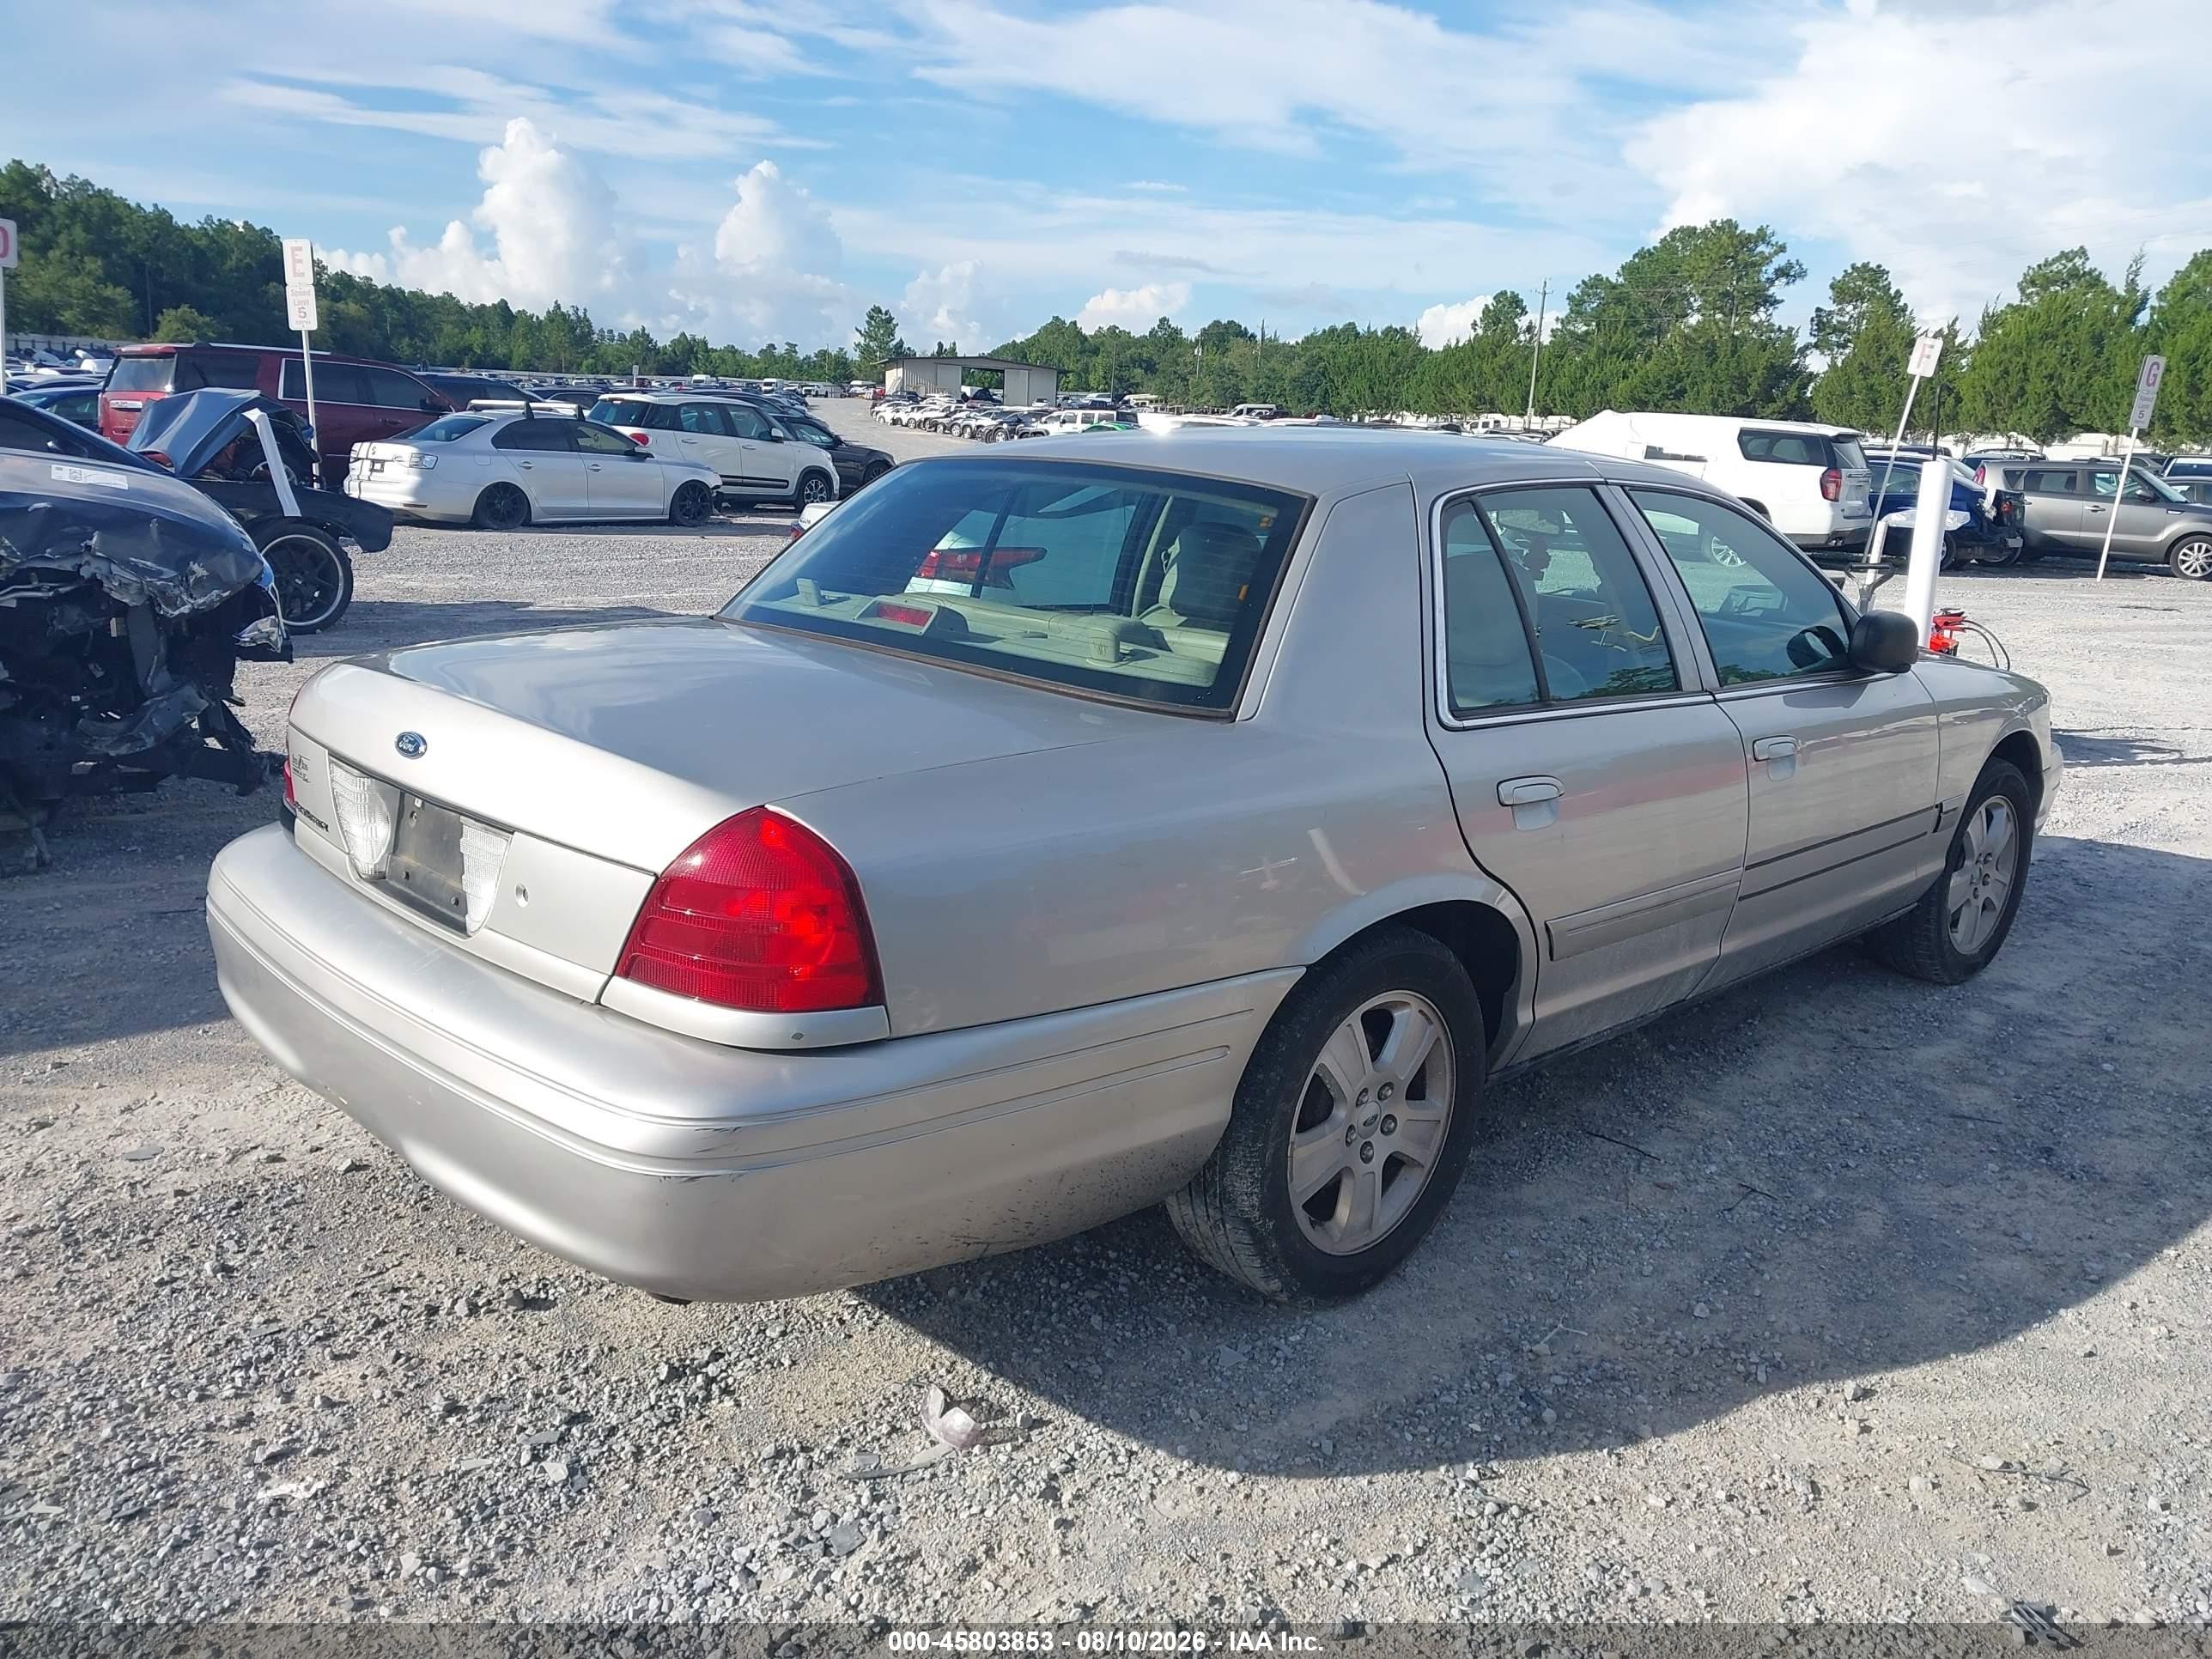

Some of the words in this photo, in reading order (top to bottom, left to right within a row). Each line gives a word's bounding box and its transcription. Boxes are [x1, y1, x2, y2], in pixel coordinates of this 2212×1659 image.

[290, 246, 305, 277] E
[297, 307, 307, 319] 5
[1917, 343, 1935, 368] F
[2147, 362, 2160, 387] G
[2138, 410, 2145, 419] 5
[398, 735, 417, 752] Ford
